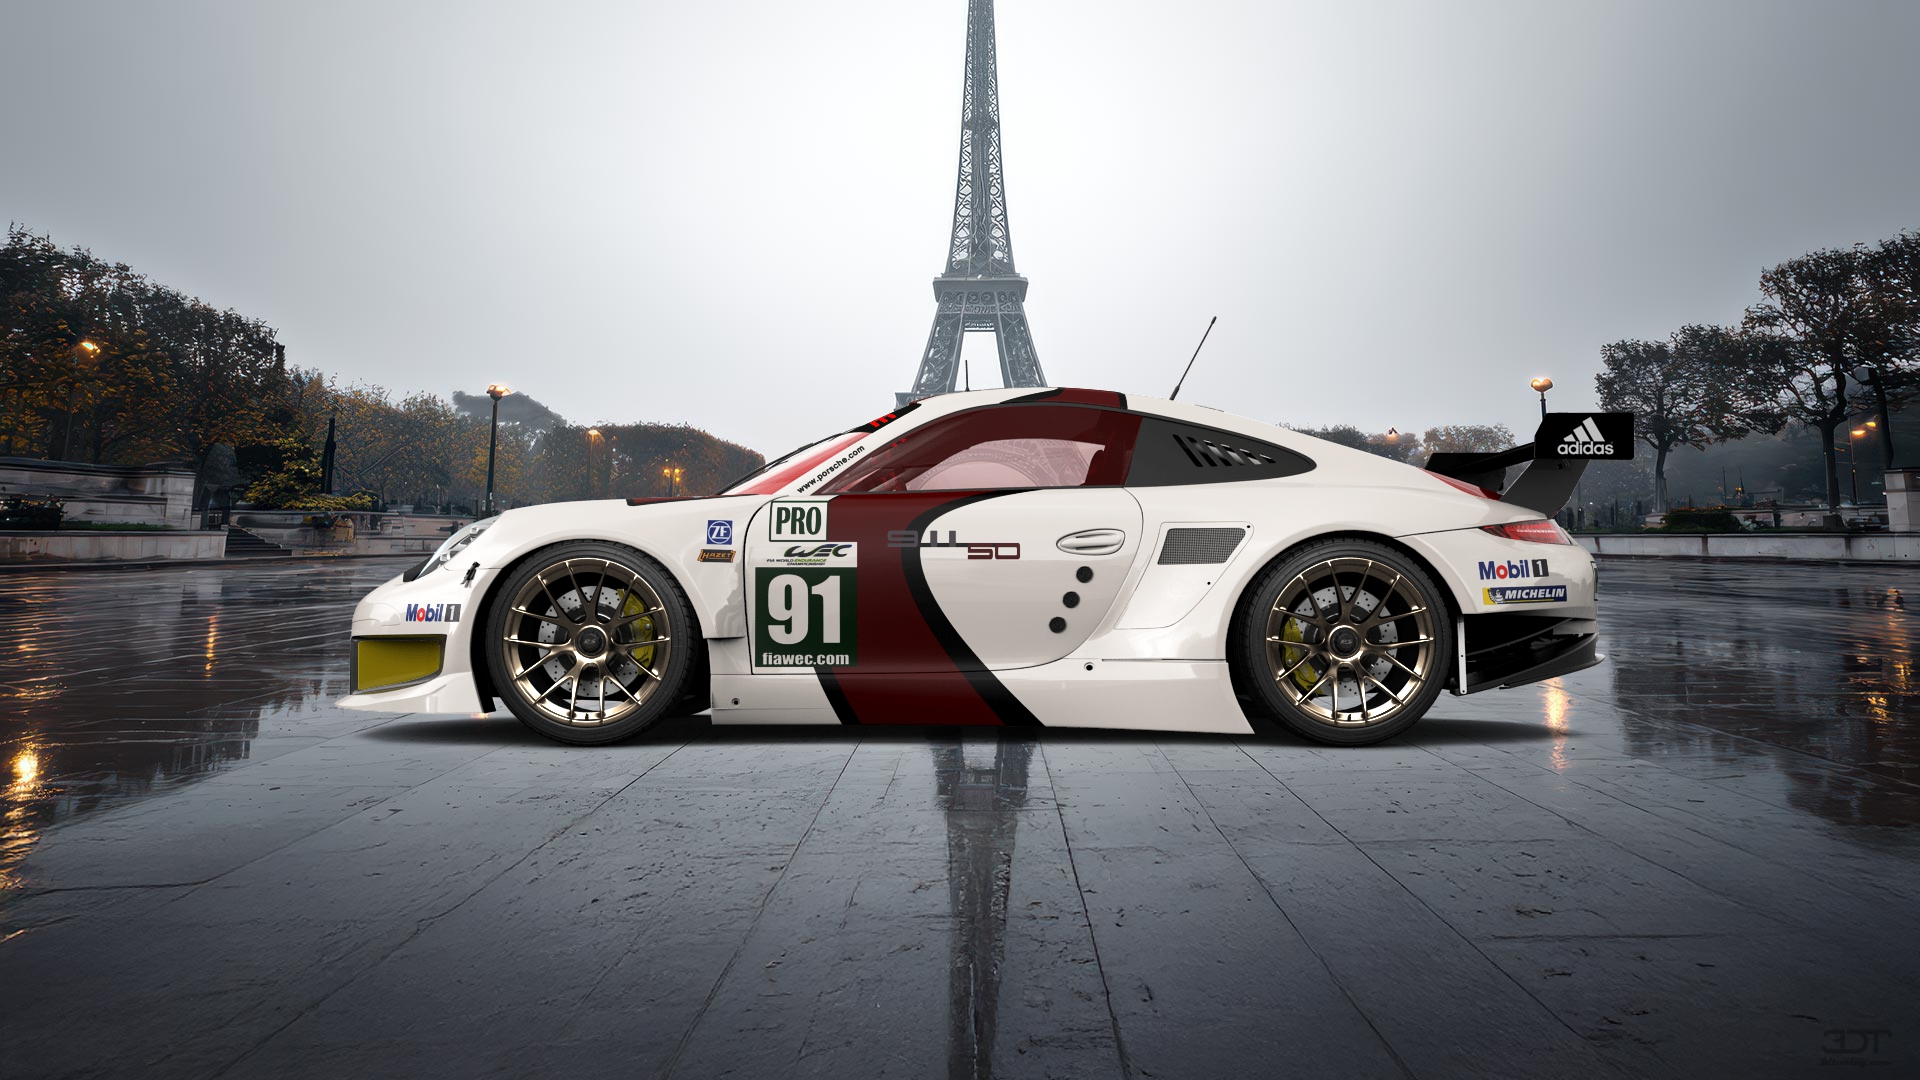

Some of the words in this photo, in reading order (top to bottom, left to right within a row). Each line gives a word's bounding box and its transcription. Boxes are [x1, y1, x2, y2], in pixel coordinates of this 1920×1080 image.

[1557, 441, 1614, 455] adidas
[797, 445, 865, 493] www.porsche.com
[776, 506, 822, 535] PRO
[712, 526, 728, 538] ZF
[784, 544, 853, 557] WEC
[1478, 559, 1530, 580] Mobil
[1505, 588, 1565, 600] MICHELIN
[405, 603, 444, 622] Mobil
[767, 574, 841, 645] 91
[762, 652, 850, 665] fiawec.com
